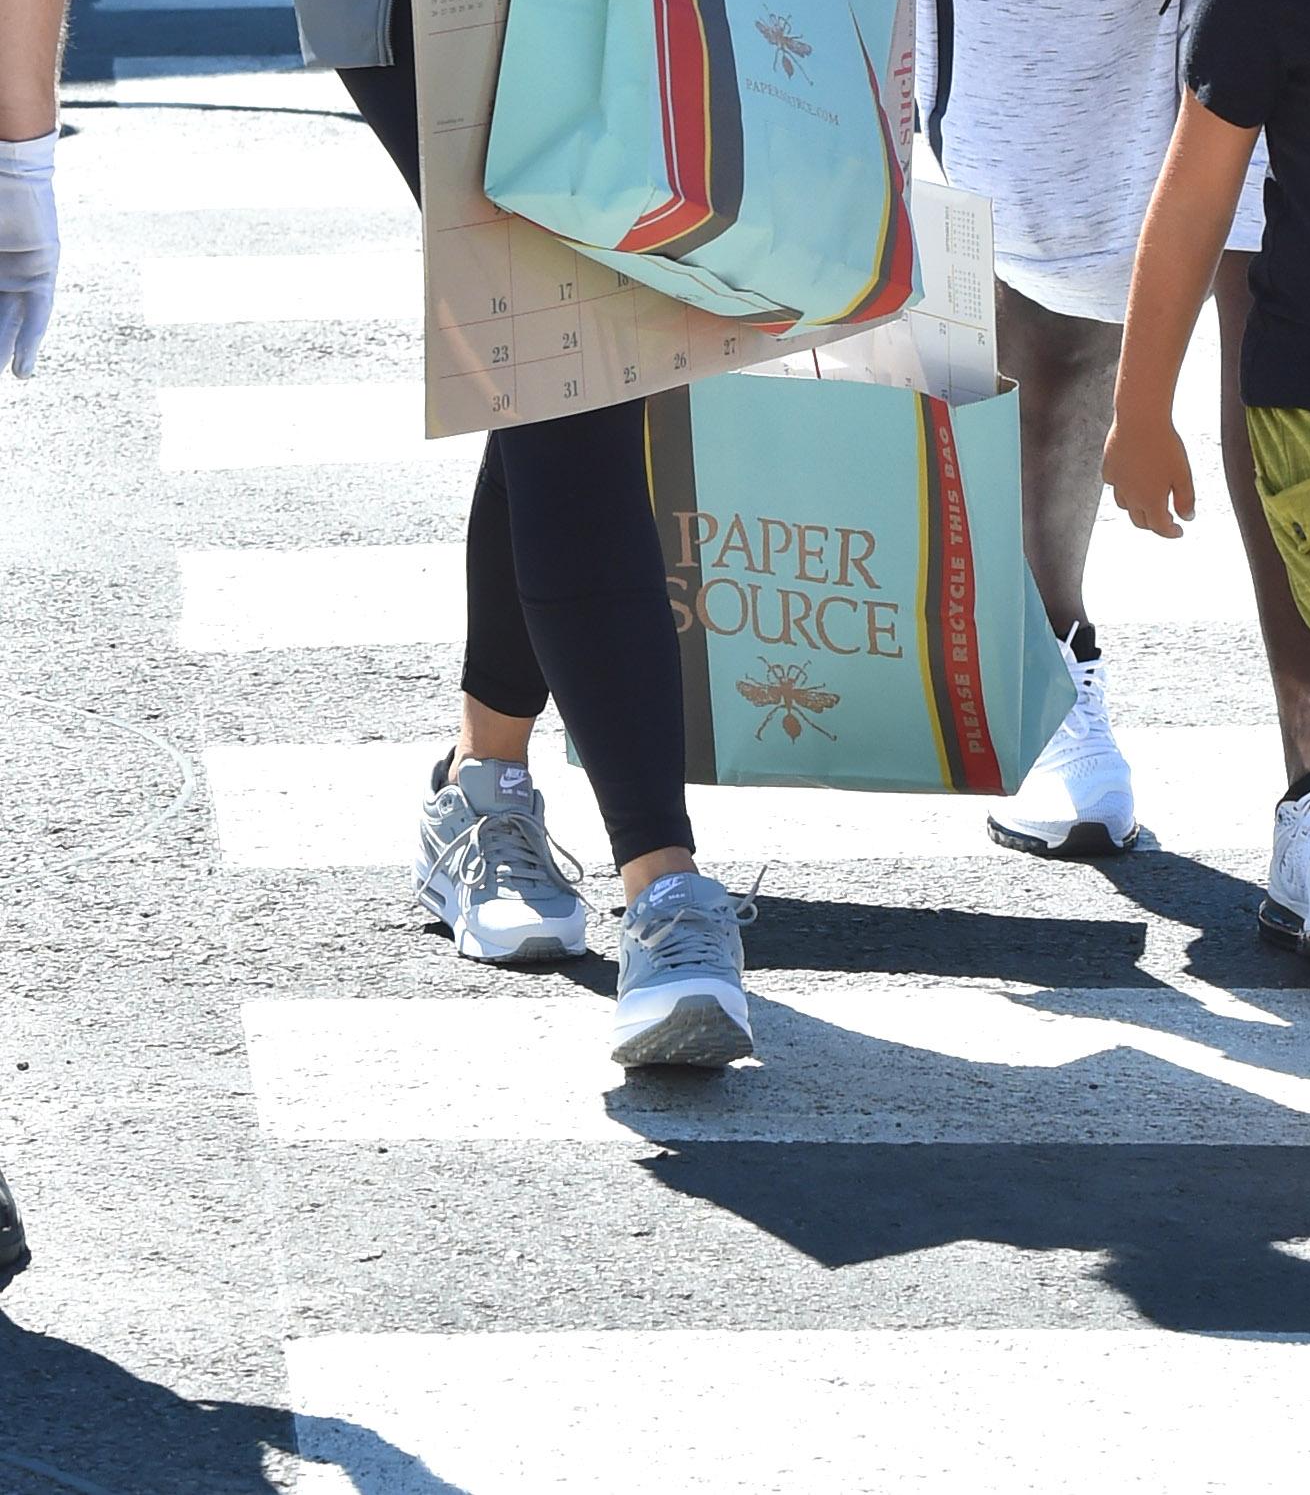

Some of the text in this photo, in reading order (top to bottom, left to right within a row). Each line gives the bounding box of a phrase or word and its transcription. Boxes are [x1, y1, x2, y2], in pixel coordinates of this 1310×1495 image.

[893, 49, 913, 146] such
[559, 282, 573, 302] 17
[490, 296, 507, 315] 16
[562, 332, 578, 349] 24
[724, 337, 737, 356] 27
[492, 345, 509, 363] 23
[674, 352, 687, 370] 26
[624, 366, 637, 384] 25
[564, 380, 579, 398] 31
[492, 394, 510, 412] 30
[948, 489, 966, 545] THIS
[672, 511, 882, 590] PAPER
[665, 576, 903, 658] SOURCE
[948, 556, 969, 662] RECYCLE
[955, 673, 985, 754] PLEASE
[505, 767, 528, 779] NIKE
